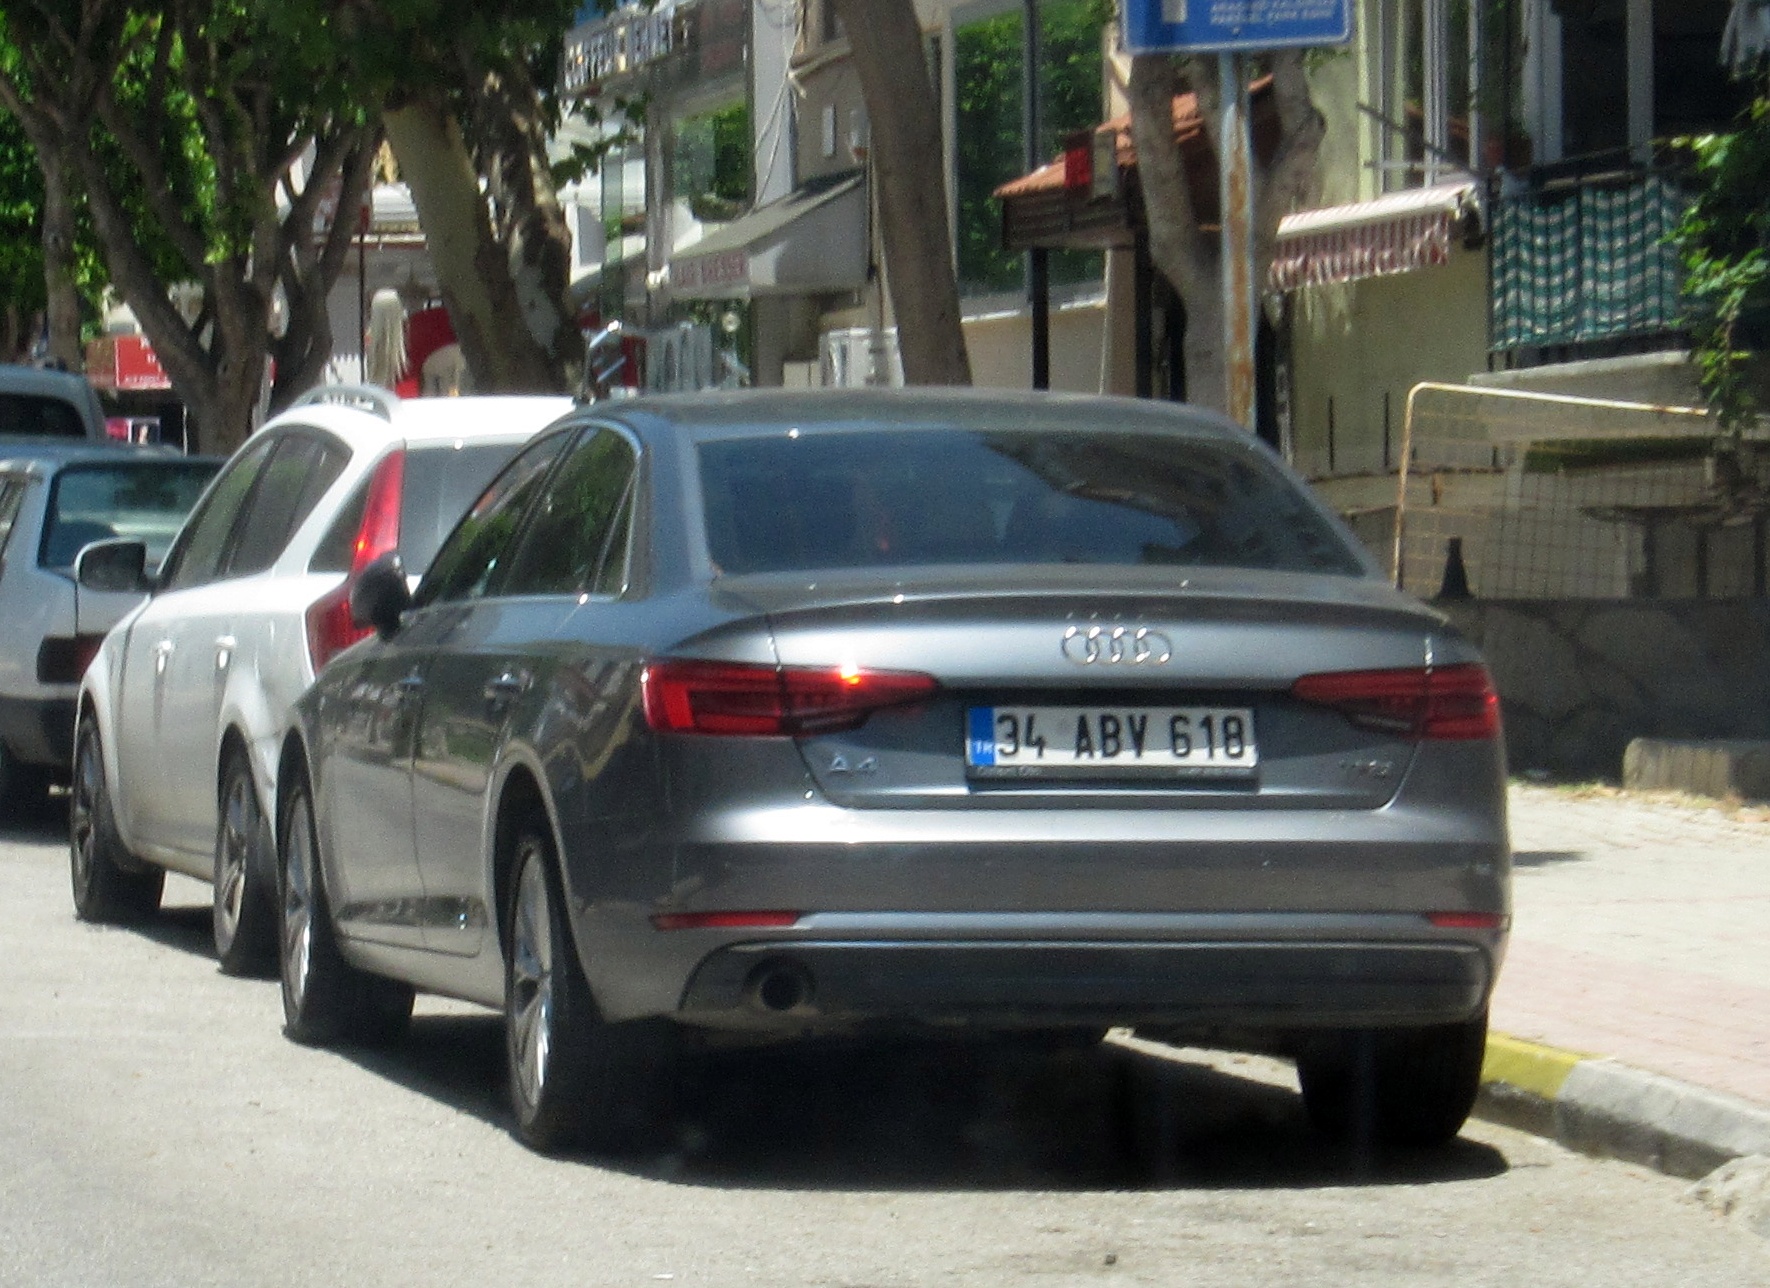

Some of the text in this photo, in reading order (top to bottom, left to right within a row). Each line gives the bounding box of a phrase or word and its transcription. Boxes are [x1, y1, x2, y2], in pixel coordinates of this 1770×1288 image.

[997, 714, 1245, 760] 34 ABV 618
